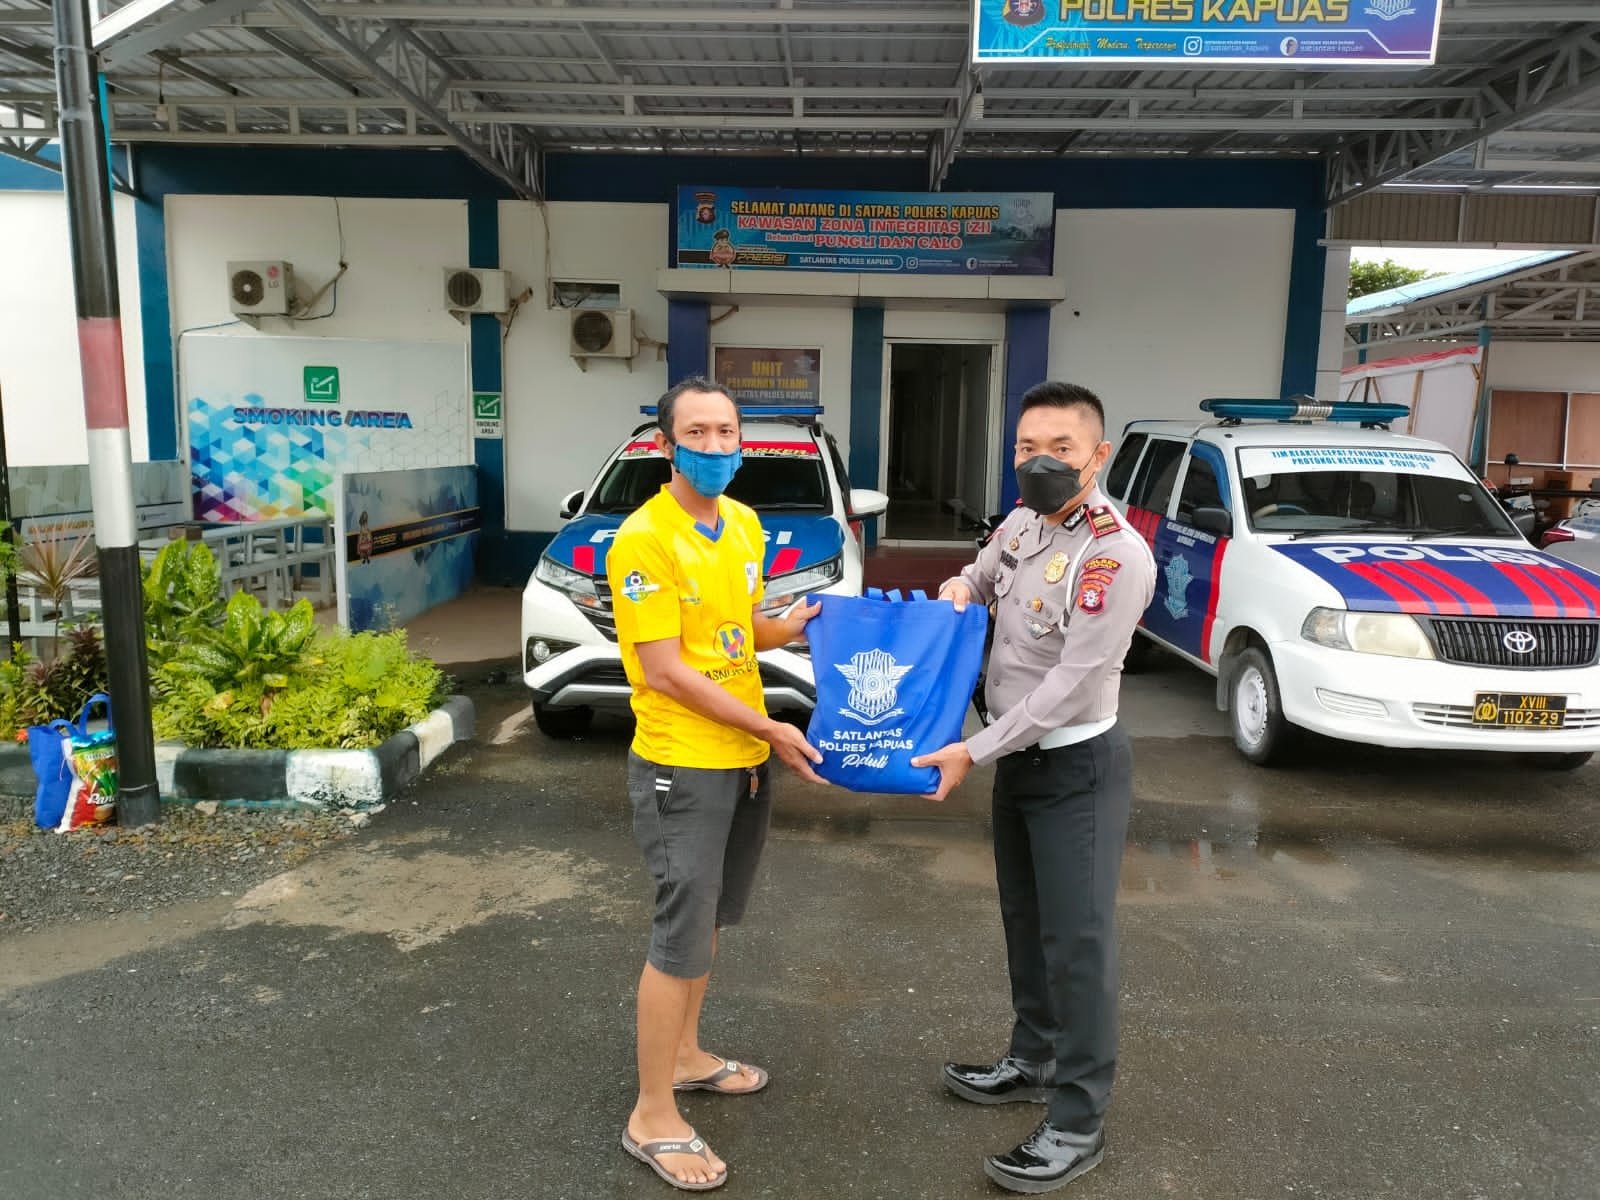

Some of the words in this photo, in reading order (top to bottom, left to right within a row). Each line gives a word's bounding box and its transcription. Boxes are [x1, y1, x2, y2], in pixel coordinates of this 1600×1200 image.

[1060, 0, 1194, 21] POLRES
[1201, 0, 1349, 22] KAPUAS
[731, 201, 785, 214] SELAMAT
[788, 203, 835, 216] DATANG
[839, 205, 851, 216] DI
[855, 205, 900, 217] SATPAS
[904, 205, 947, 218] POLRES
[951, 206, 999, 219] KAPUAS
[738, 216, 815, 230] KAWASAN
[820, 218, 865, 232] ZONA
[869, 219, 960, 233] INTEGRITAS
[814, 233, 876, 247] PUNGLI
[879, 236, 914, 248] DAN
[917, 236, 962, 249] CALO
[268, 280, 280, 289] LG
[232, 407, 343, 428] SMOKING
[345, 410, 413, 429] AREA
[1311, 546, 1564, 569] POLISI
[1520, 695, 1547, 709] XVIII
[1503, 711, 1559, 725] 1102-29
[833, 728, 903, 740] SATLANTAS
[819, 740, 866, 752] POLRES
